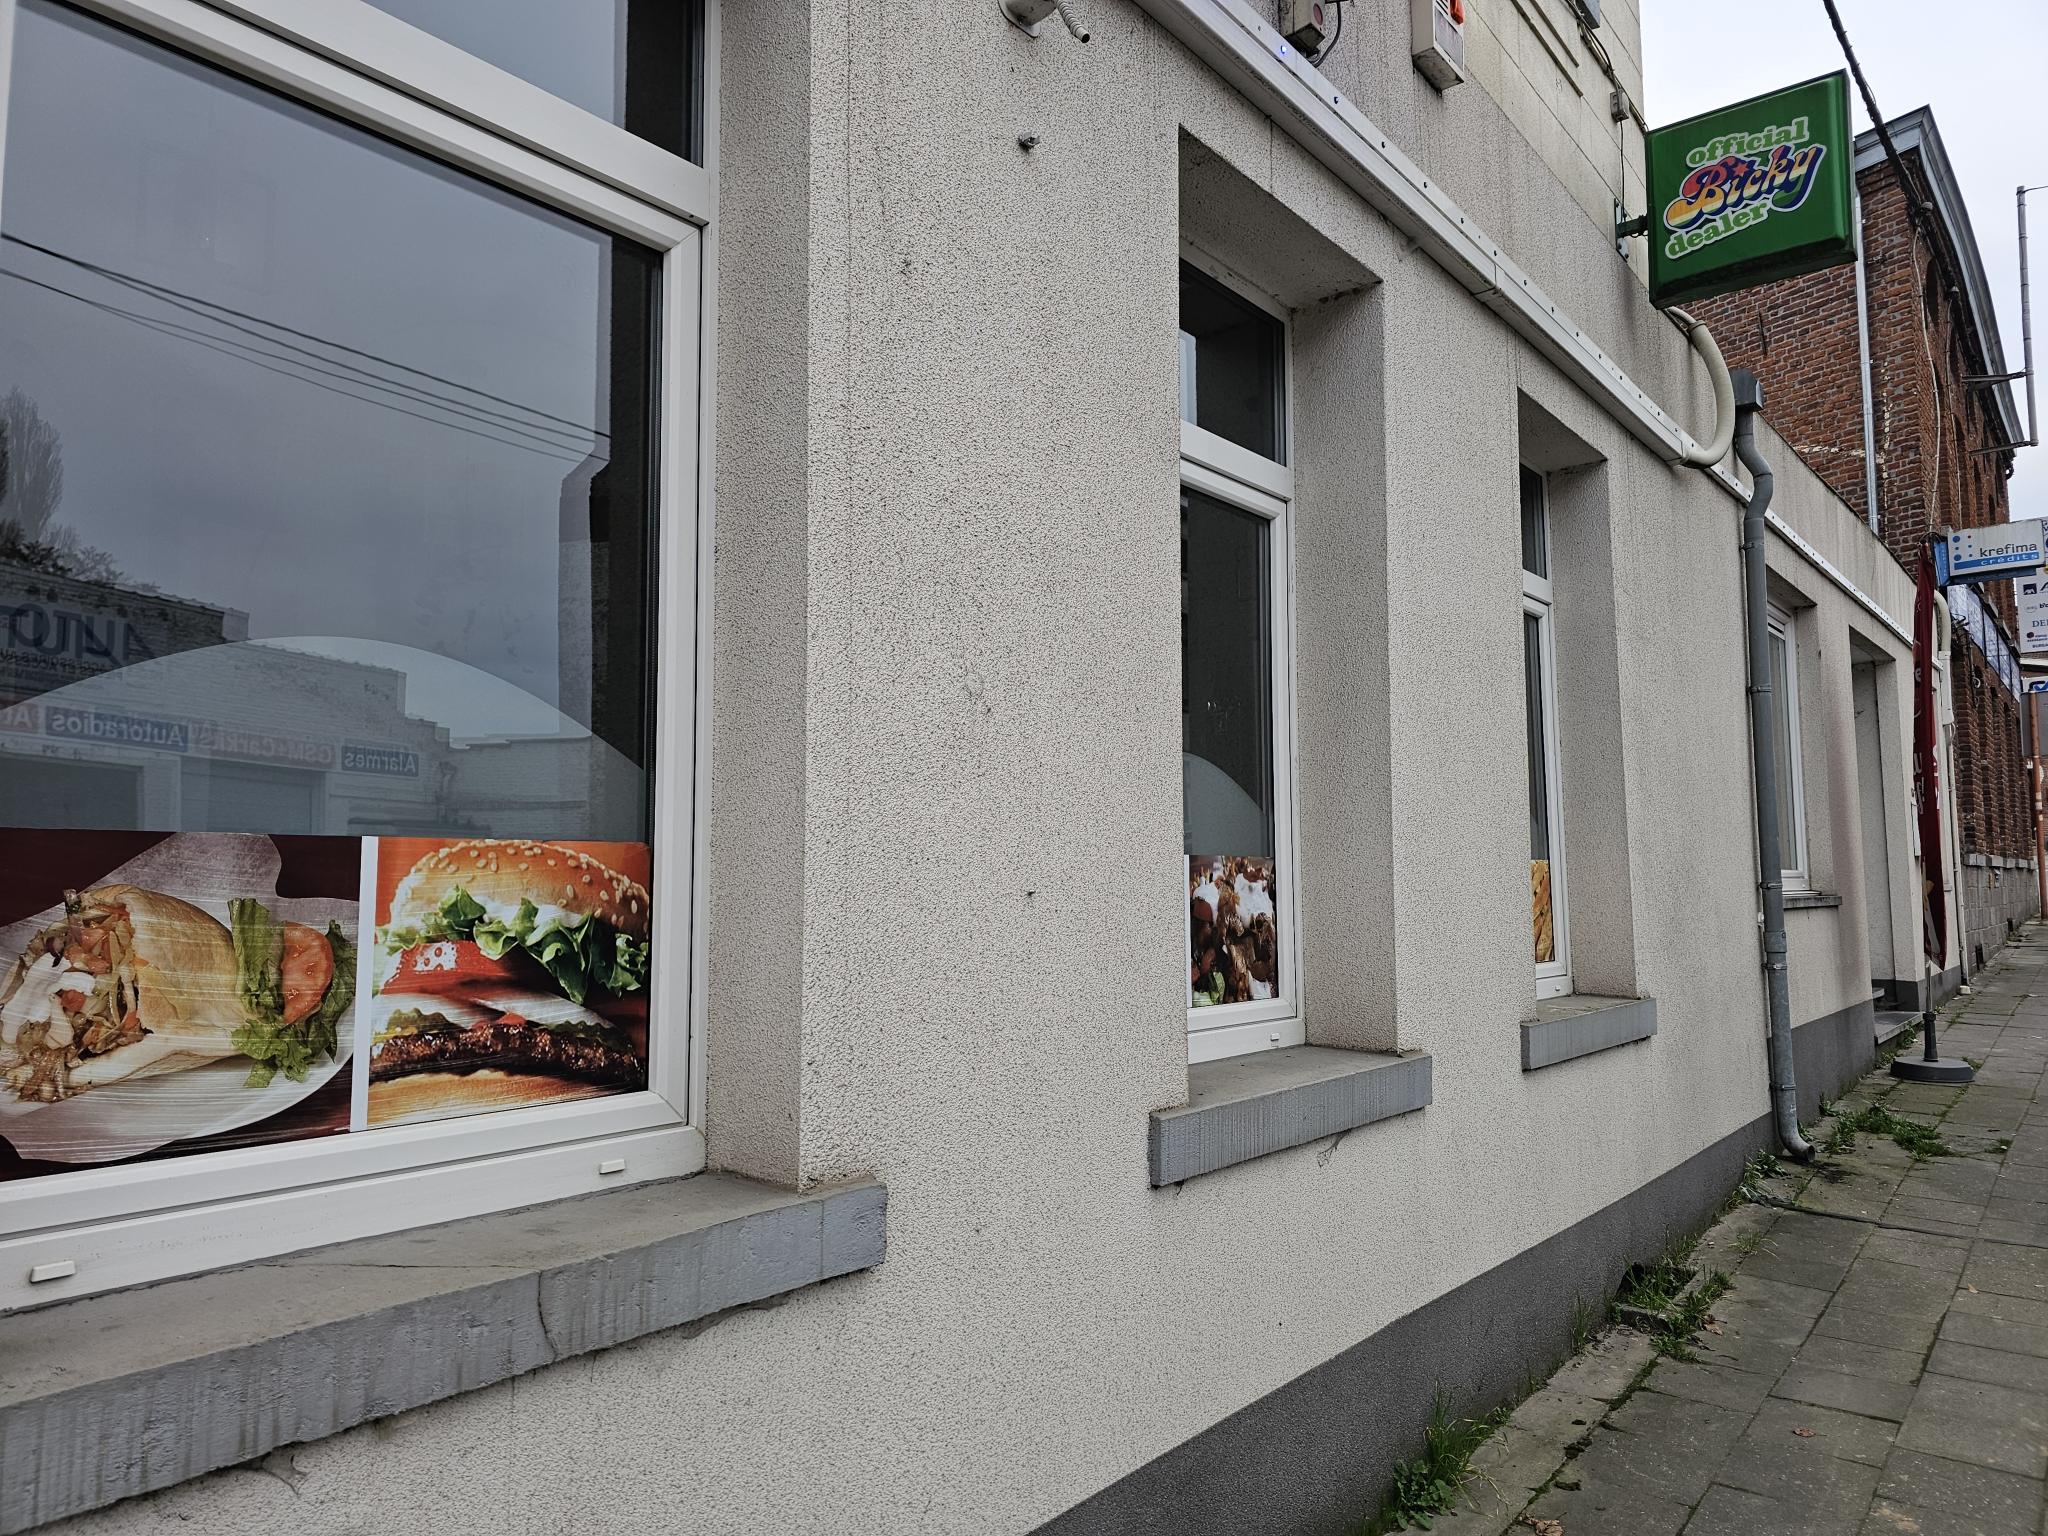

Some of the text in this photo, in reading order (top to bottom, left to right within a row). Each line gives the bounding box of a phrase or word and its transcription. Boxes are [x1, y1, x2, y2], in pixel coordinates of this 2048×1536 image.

[1687, 118, 1809, 166] official
[1664, 144, 1826, 230] Bicky
[1666, 202, 1768, 258] dealer
[1980, 543, 2037, 558] krefima
